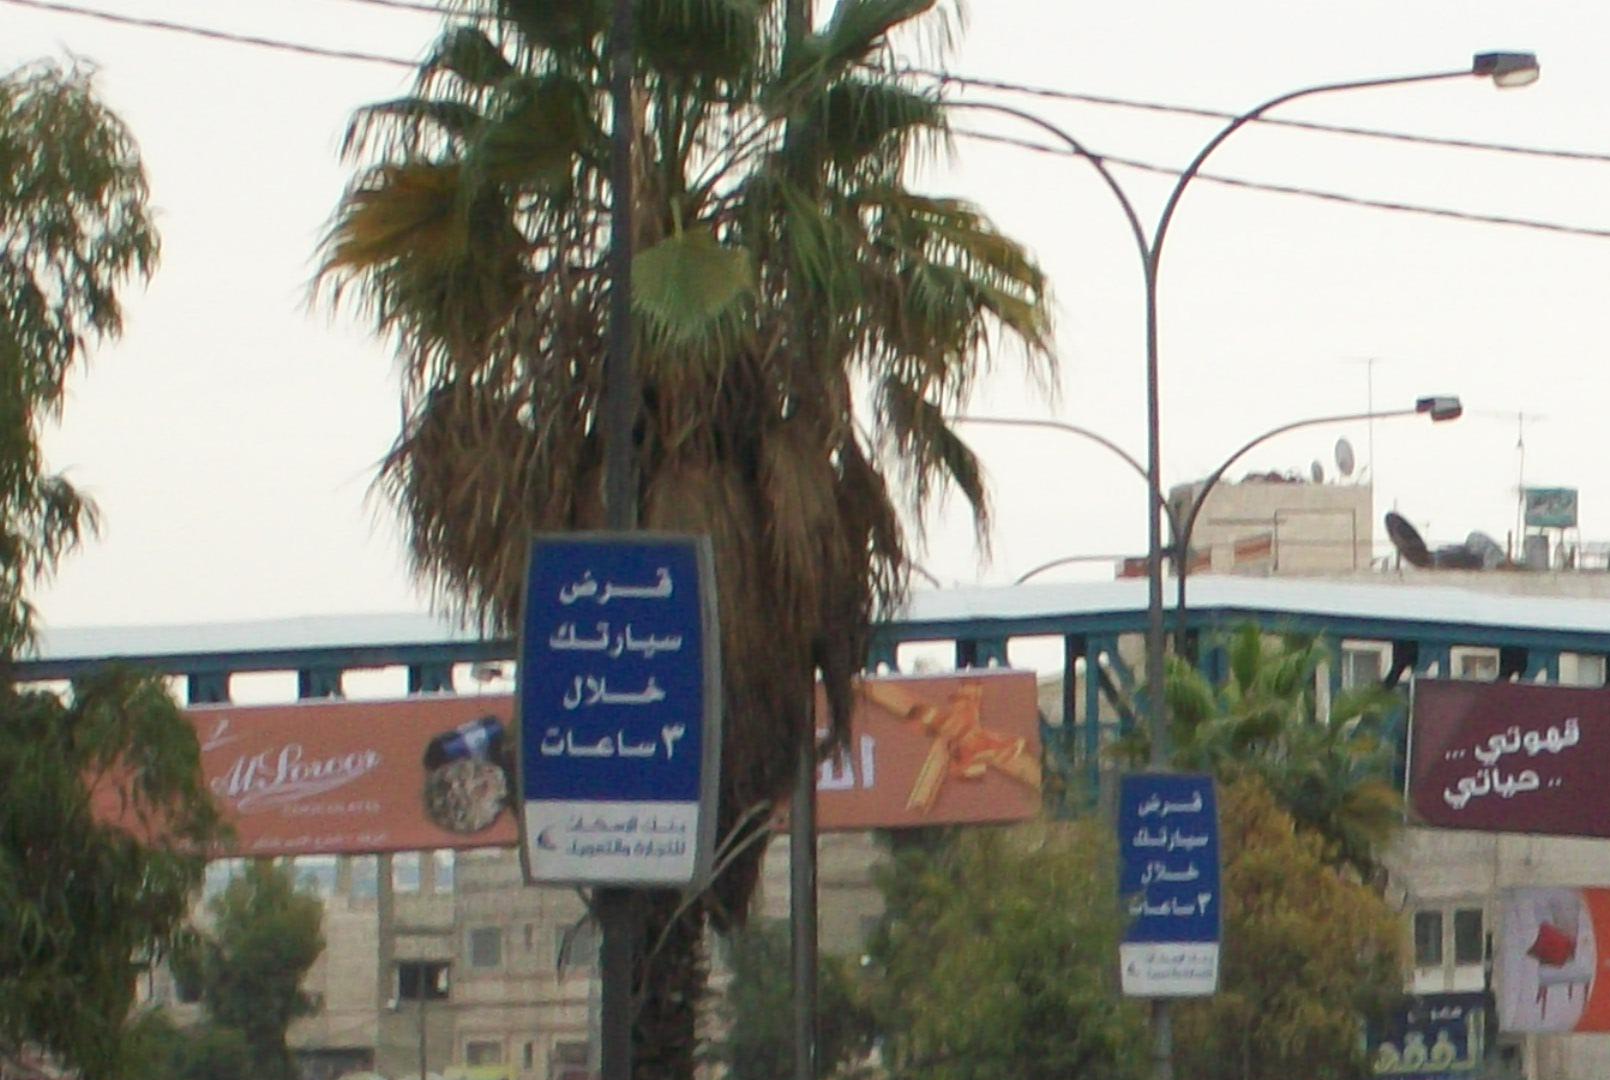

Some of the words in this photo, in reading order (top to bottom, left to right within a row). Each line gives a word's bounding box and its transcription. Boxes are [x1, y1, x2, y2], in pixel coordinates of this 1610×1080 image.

[560, 567, 673, 604] قرض
[550, 622, 682, 658] سيارتك
[563, 675, 666, 709] خلال
[540, 725, 656, 757] ساعات
[661, 724, 685, 759] ٣
[1474, 716, 1580, 767] قهوتي
[1137, 790, 1203, 817] قرض
[1443, 764, 1540, 810] حياتي
[1133, 826, 1209, 851] سيارتك
[1140, 861, 1200, 884] خلال
